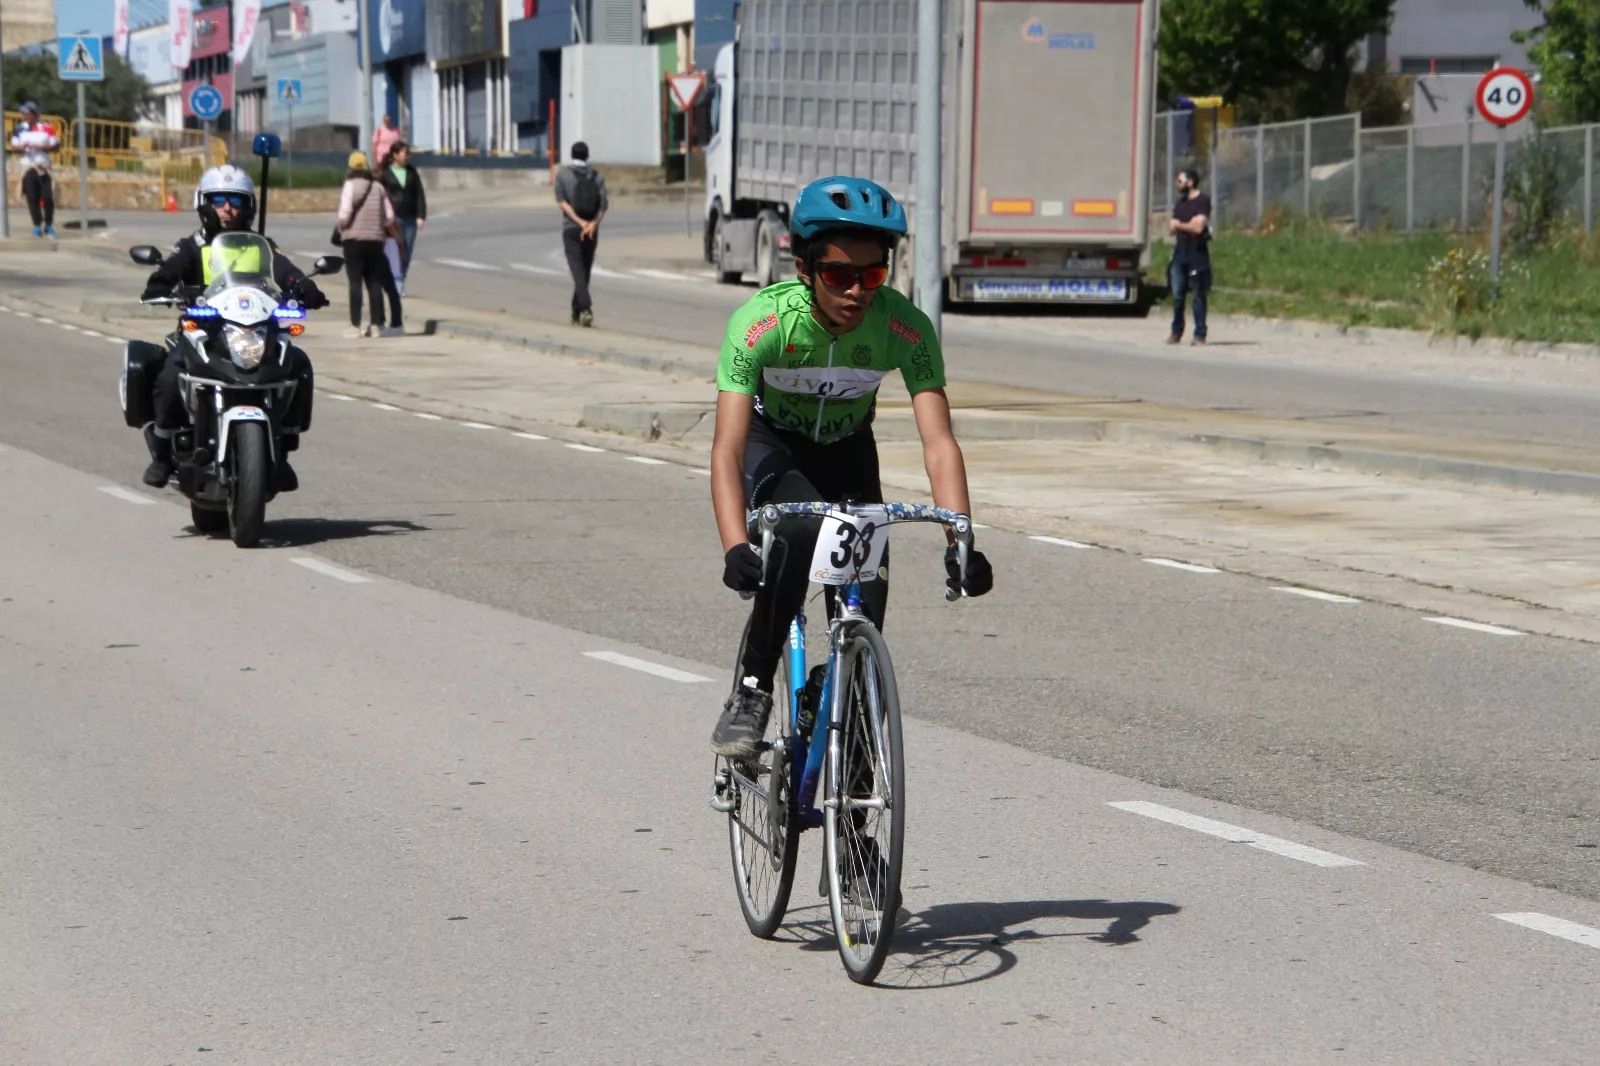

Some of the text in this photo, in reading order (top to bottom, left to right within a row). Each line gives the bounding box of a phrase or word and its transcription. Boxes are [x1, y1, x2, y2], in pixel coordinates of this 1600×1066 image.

[1487, 87, 1522, 105] 40
[1048, 279, 1124, 293] MOLAS
[831, 521, 875, 569] 33
